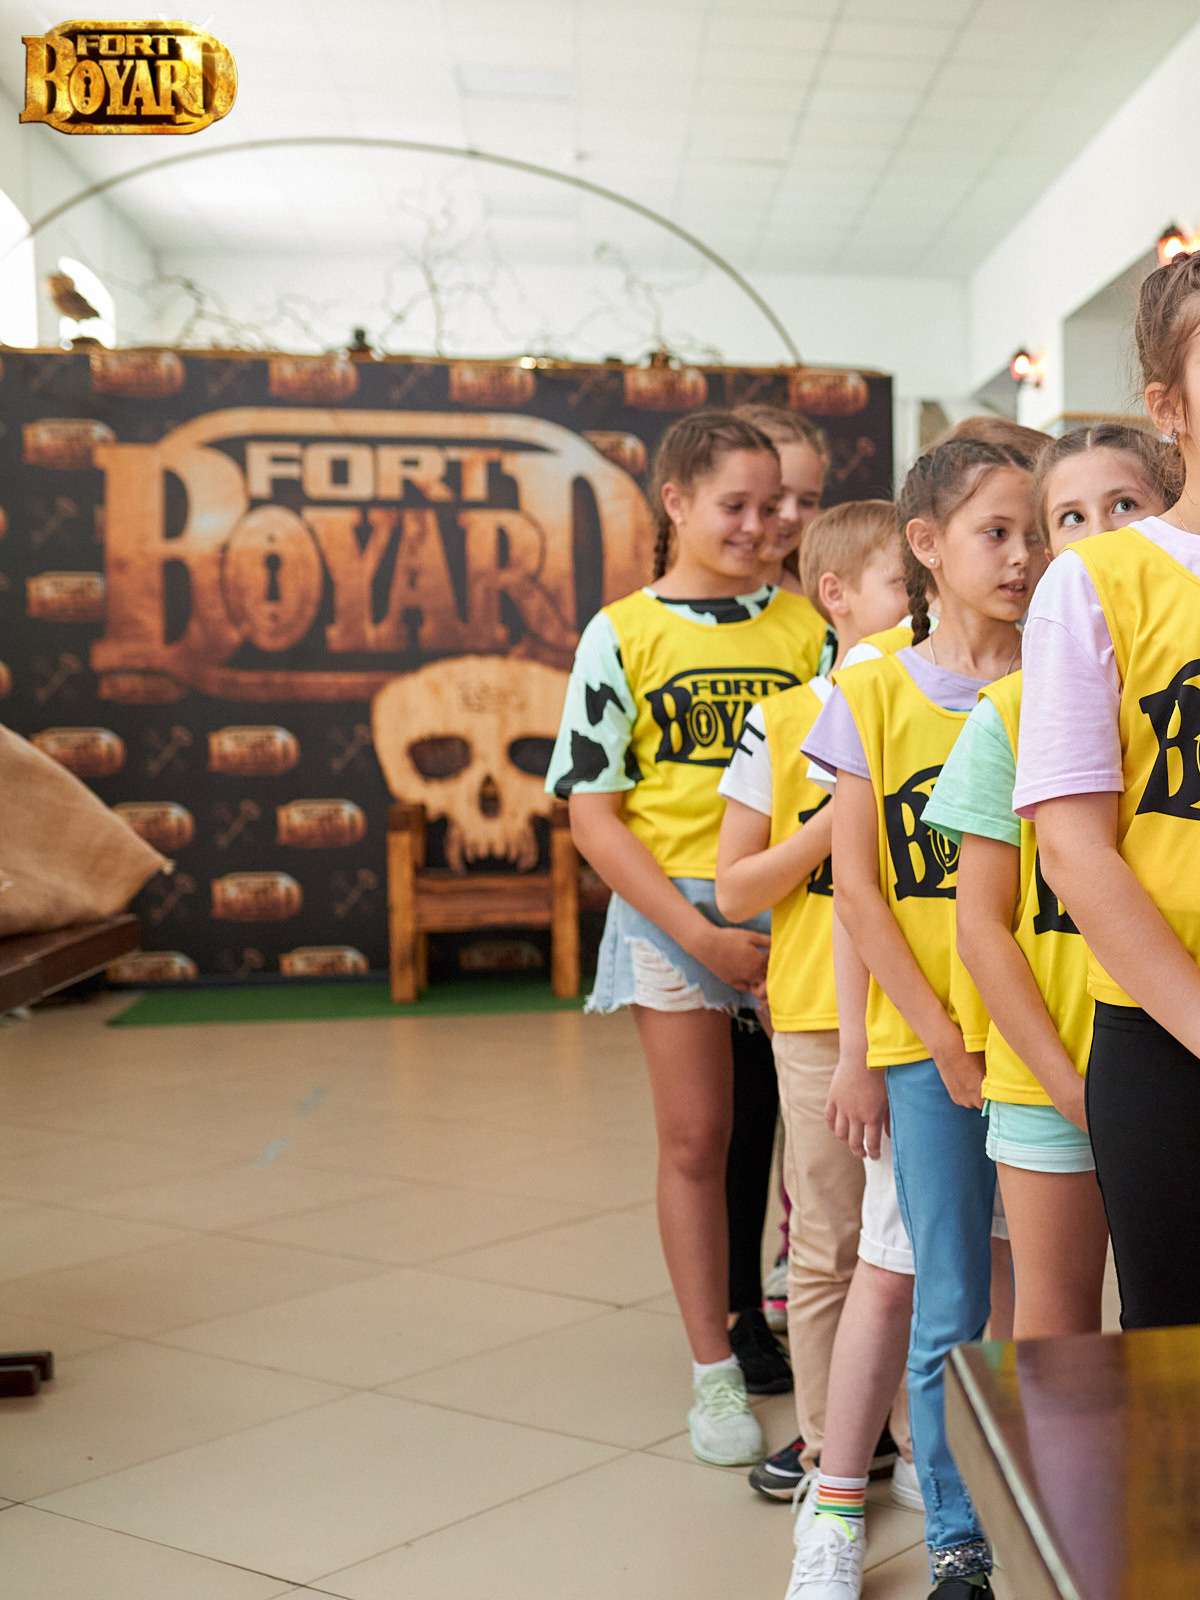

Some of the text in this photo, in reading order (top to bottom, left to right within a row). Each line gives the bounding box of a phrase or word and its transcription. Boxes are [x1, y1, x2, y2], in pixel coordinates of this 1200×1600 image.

[246, 443, 503, 501] FORT
[91, 436, 652, 692] BOYARD
[691, 680, 774, 696] FORT
